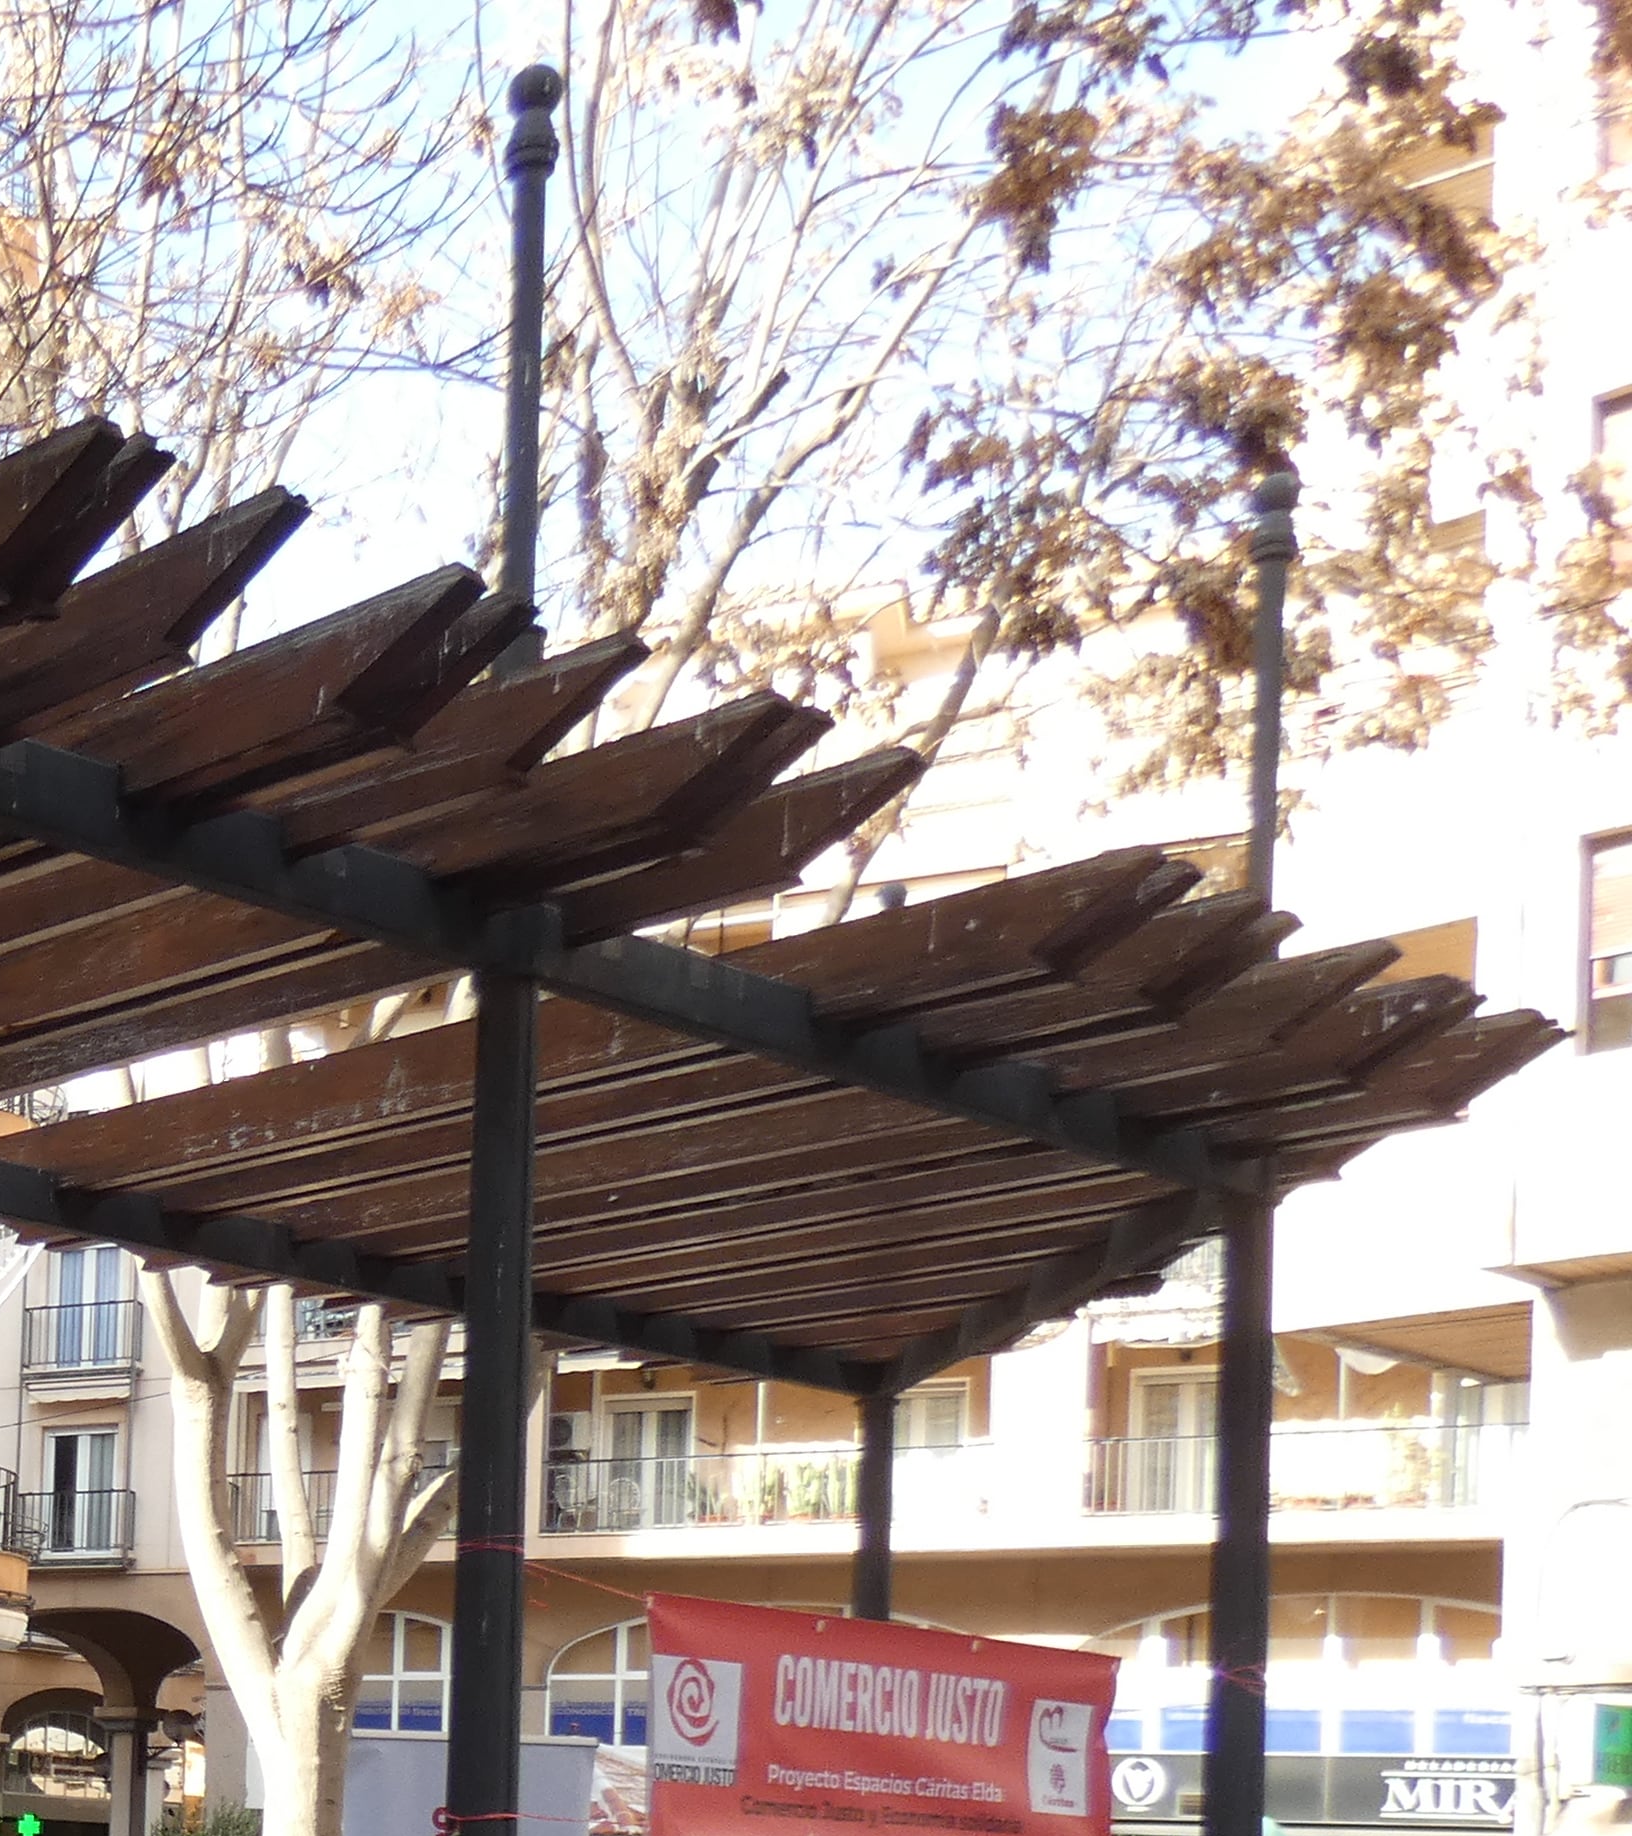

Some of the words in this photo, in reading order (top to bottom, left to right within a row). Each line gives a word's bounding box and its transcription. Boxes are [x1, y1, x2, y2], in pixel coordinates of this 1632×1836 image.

[774, 1653, 921, 1739] COMERCIO
[924, 1672, 1007, 1748] JUSTO
[767, 1764, 841, 1791] Proyecto
[843, 1770, 913, 1796] Espacios
[971, 1780, 1005, 1802] Elda
